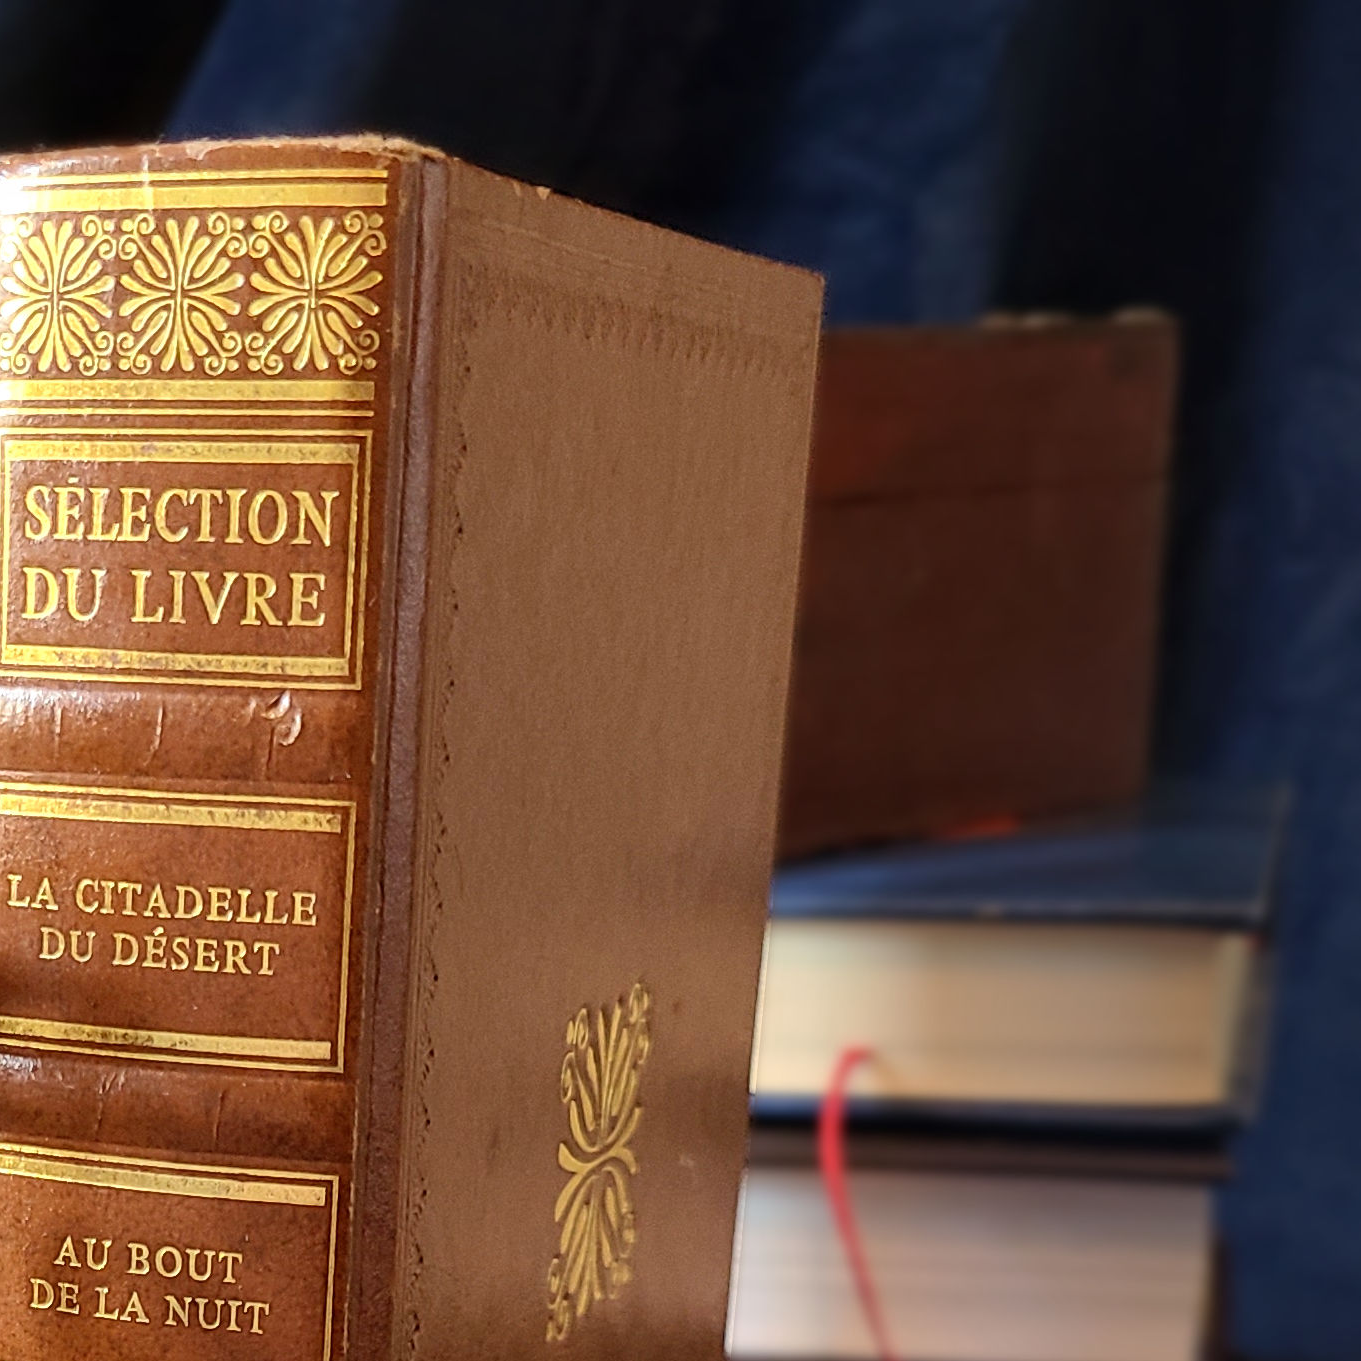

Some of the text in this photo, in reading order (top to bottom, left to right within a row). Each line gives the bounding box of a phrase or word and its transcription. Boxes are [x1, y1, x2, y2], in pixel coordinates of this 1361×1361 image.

[24, 477, 340, 547] SÉLECTION
[21, 566, 326, 628] DU LIVRE
[6, 874, 318, 927] LA CITADELLE
[38, 927, 280, 976] DU DÉSERT
[54, 1236, 243, 1284] AU BOUT
[29, 1278, 270, 1335] DE LA NUIT
